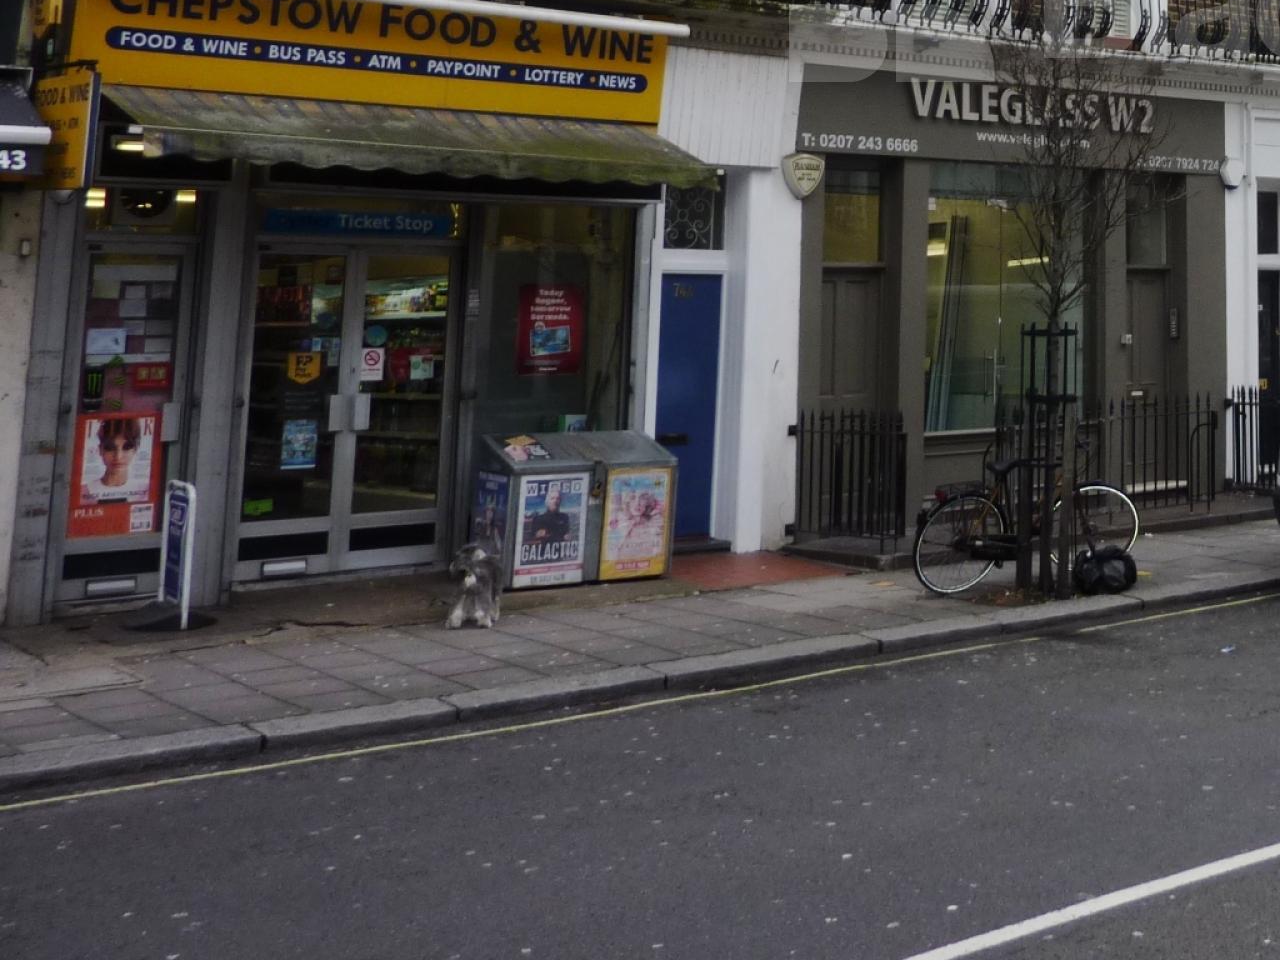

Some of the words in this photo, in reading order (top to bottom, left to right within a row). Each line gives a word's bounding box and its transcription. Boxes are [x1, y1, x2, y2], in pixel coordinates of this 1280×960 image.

[379, 3, 497, 47] FOOD
[513, 19, 541, 53] &
[562, 22, 654, 64] WINE
[120, 30, 177, 49] FOOD
[182, 38, 195, 52] &
[202, 38, 248, 56] WINE
[268, 44, 301, 60] BUS
[306, 48, 346, 65] PASS
[367, 54, 401, 71] ATM
[427, 58, 501, 79] PAYPOINT
[524, 68, 584, 85] LOTTERY
[598, 73, 636, 90] NEWS
[1108, 94, 1155, 134] W2
[802, 133, 815, 147] T:
[819, 134, 854, 149] 0207
[858, 137, 883, 151] 243
[886, 138, 918, 153] 6666
[1176, 156, 1200, 171] 7924
[338, 213, 391, 230] Ticket
[395, 215, 434, 234] Stop
[521, 541, 580, 562] GALACTIC
